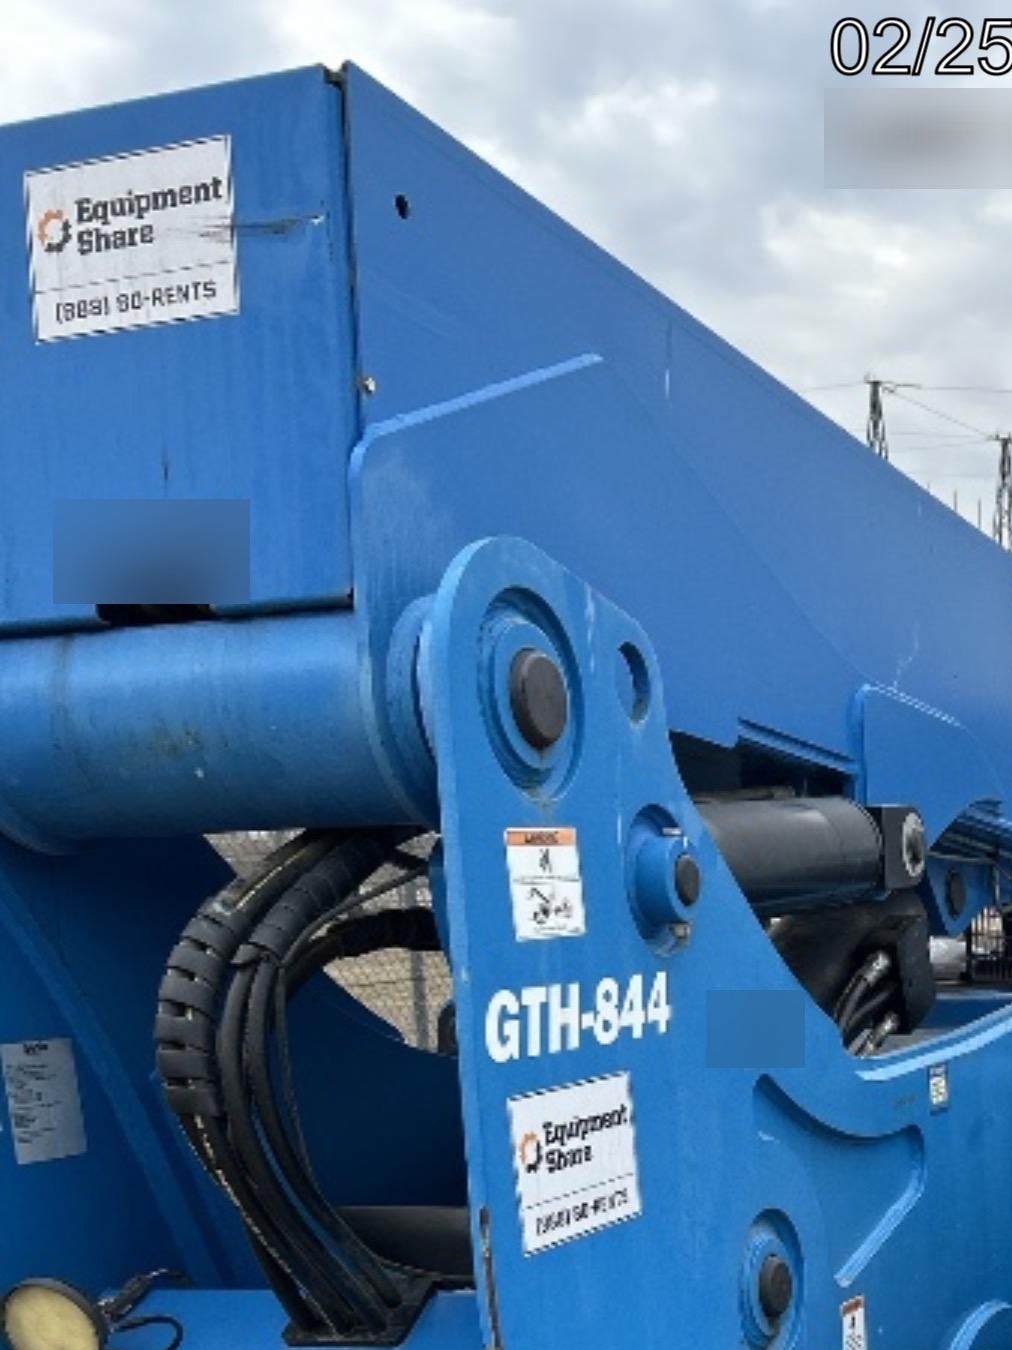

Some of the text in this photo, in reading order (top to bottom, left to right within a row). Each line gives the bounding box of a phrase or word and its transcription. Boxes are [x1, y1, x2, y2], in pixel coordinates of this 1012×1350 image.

[75, 176, 223, 225] Equipment
[77, 224, 154, 255] Share
[485, 971, 672, 1062] GTH-844
[543, 1104, 628, 1146] Equipment
